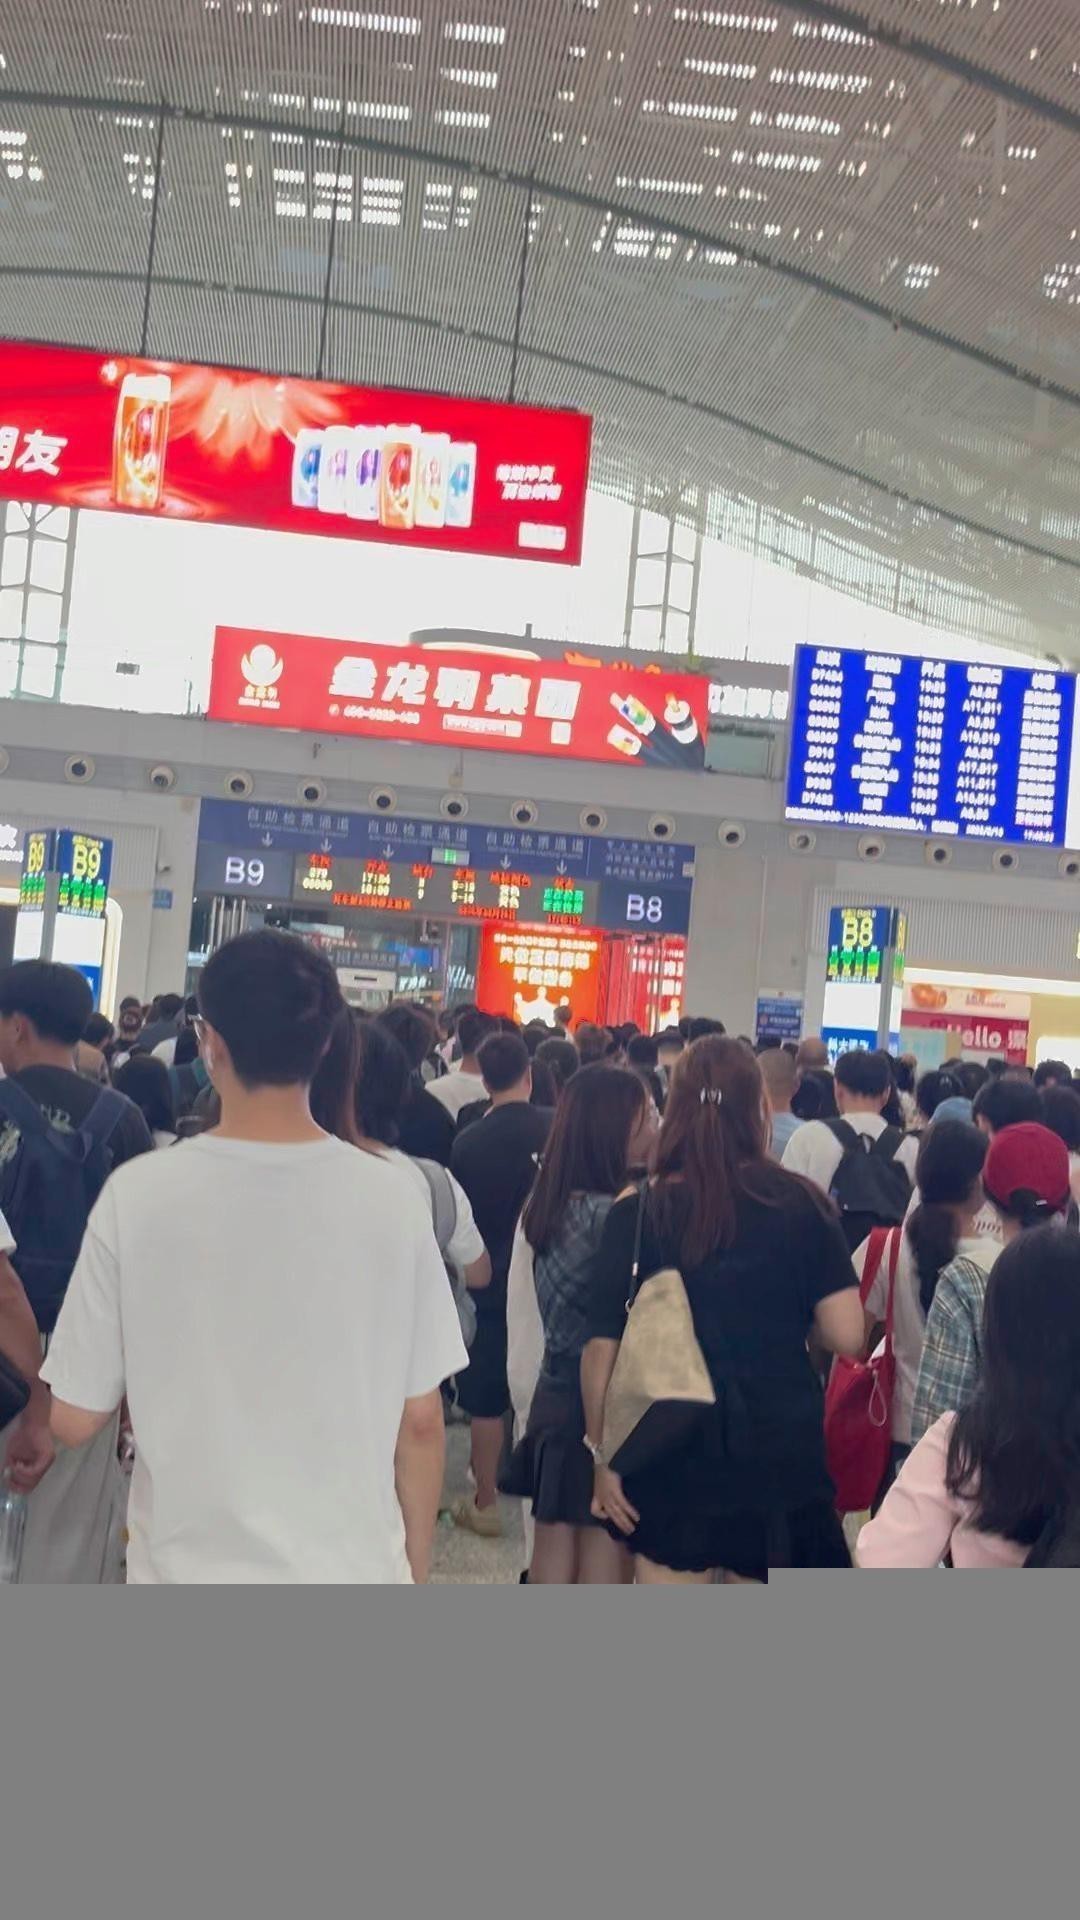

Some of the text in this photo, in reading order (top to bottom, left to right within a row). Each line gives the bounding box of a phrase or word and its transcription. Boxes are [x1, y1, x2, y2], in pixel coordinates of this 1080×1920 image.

[72, 844, 101, 879] B9
[224, 856, 265, 886] B9
[626, 893, 664, 924] B8
[842, 915, 873, 948] B8
